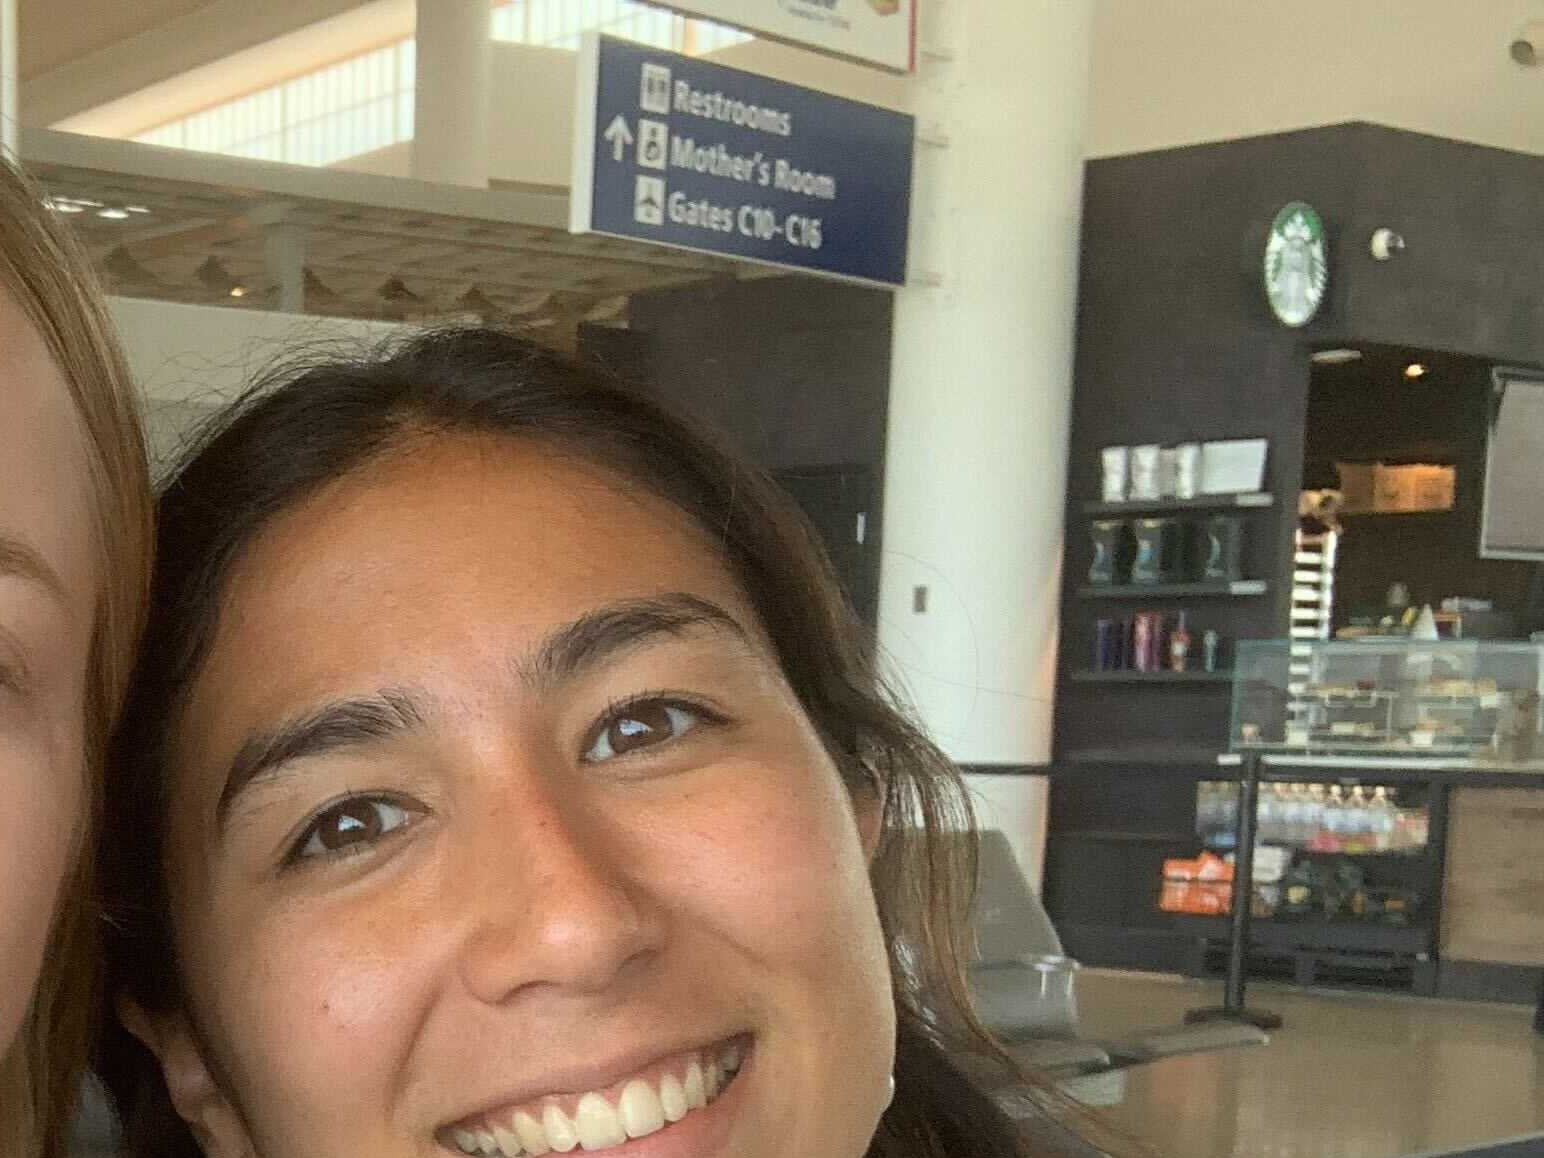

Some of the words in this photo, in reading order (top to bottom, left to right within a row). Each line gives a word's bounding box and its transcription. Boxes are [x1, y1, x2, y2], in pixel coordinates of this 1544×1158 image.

[673, 80, 791, 136] Restrooms
[671, 135, 769, 186] Mother's
[774, 159, 835, 200] Room
[668, 191, 733, 232] Gates
